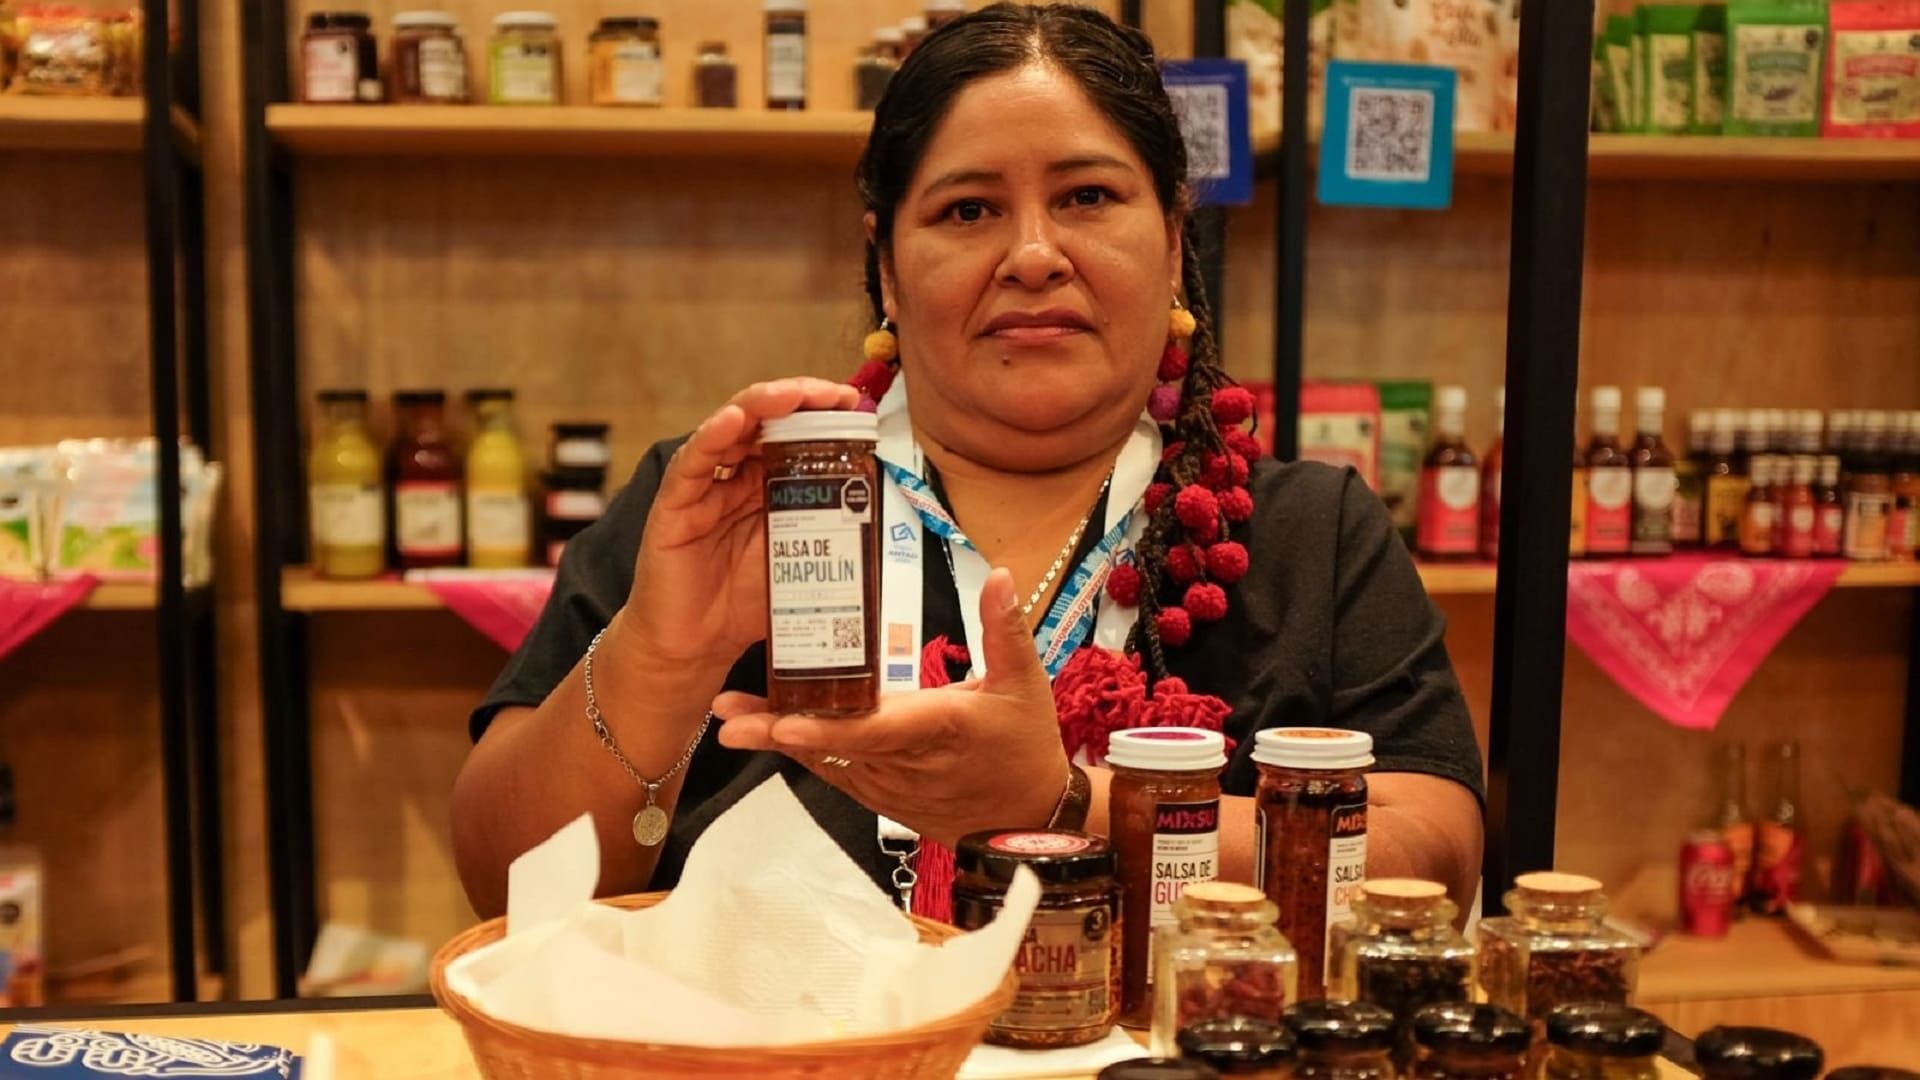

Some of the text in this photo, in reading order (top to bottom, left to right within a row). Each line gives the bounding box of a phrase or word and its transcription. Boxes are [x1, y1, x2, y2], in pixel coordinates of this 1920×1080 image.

[771, 485, 832, 505] MIXSU
[773, 538, 831, 558] SALSA DE
[773, 555, 855, 584] CHAPULÍN
[1156, 808, 1215, 829] MIXSU
[1335, 811, 1366, 833] MIX
[1155, 859, 1212, 879] SALSA DE
[1014, 944, 1076, 973] ACHA
